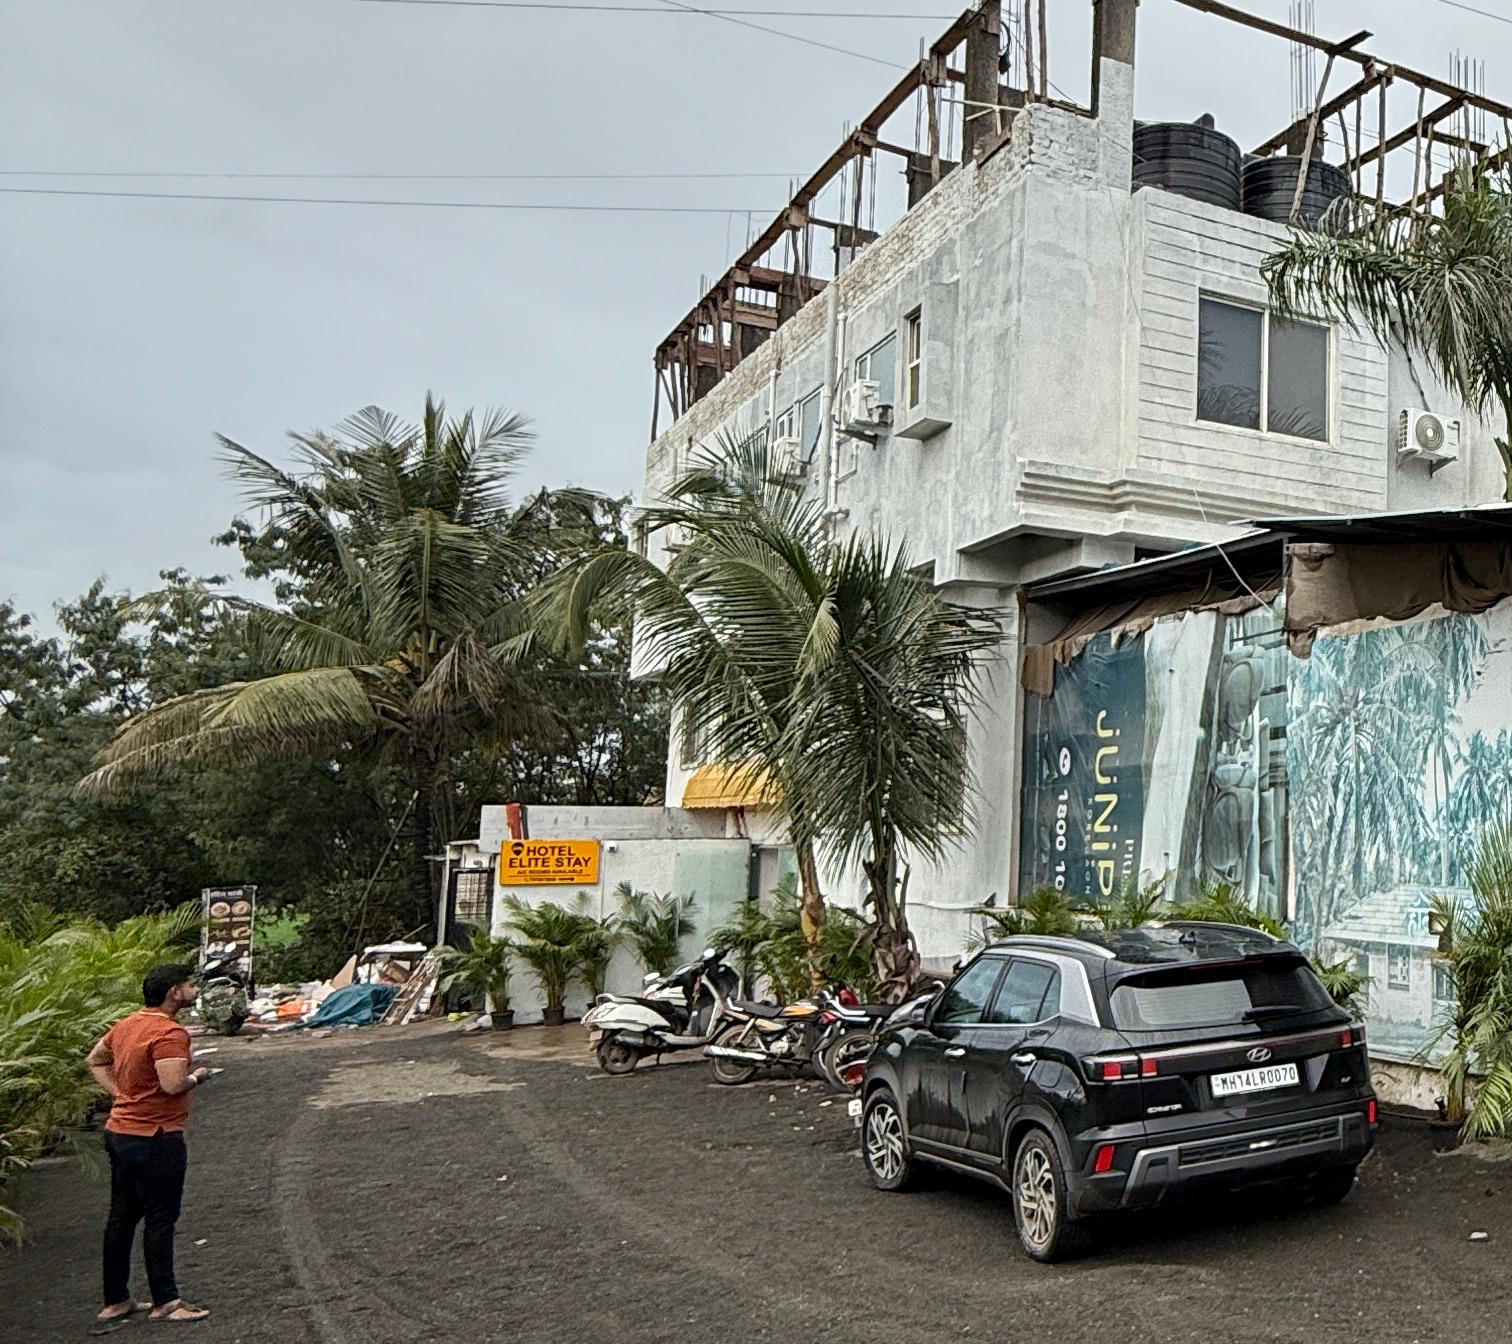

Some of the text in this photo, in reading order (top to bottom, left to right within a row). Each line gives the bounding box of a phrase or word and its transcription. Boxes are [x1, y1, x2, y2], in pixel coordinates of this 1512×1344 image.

[1055, 789, 1069, 852] 1800
[526, 845, 576, 856] HOTEL
[508, 856, 591, 868] ELITE STAY
[1220, 1066, 1297, 1092] MH14LR0070
